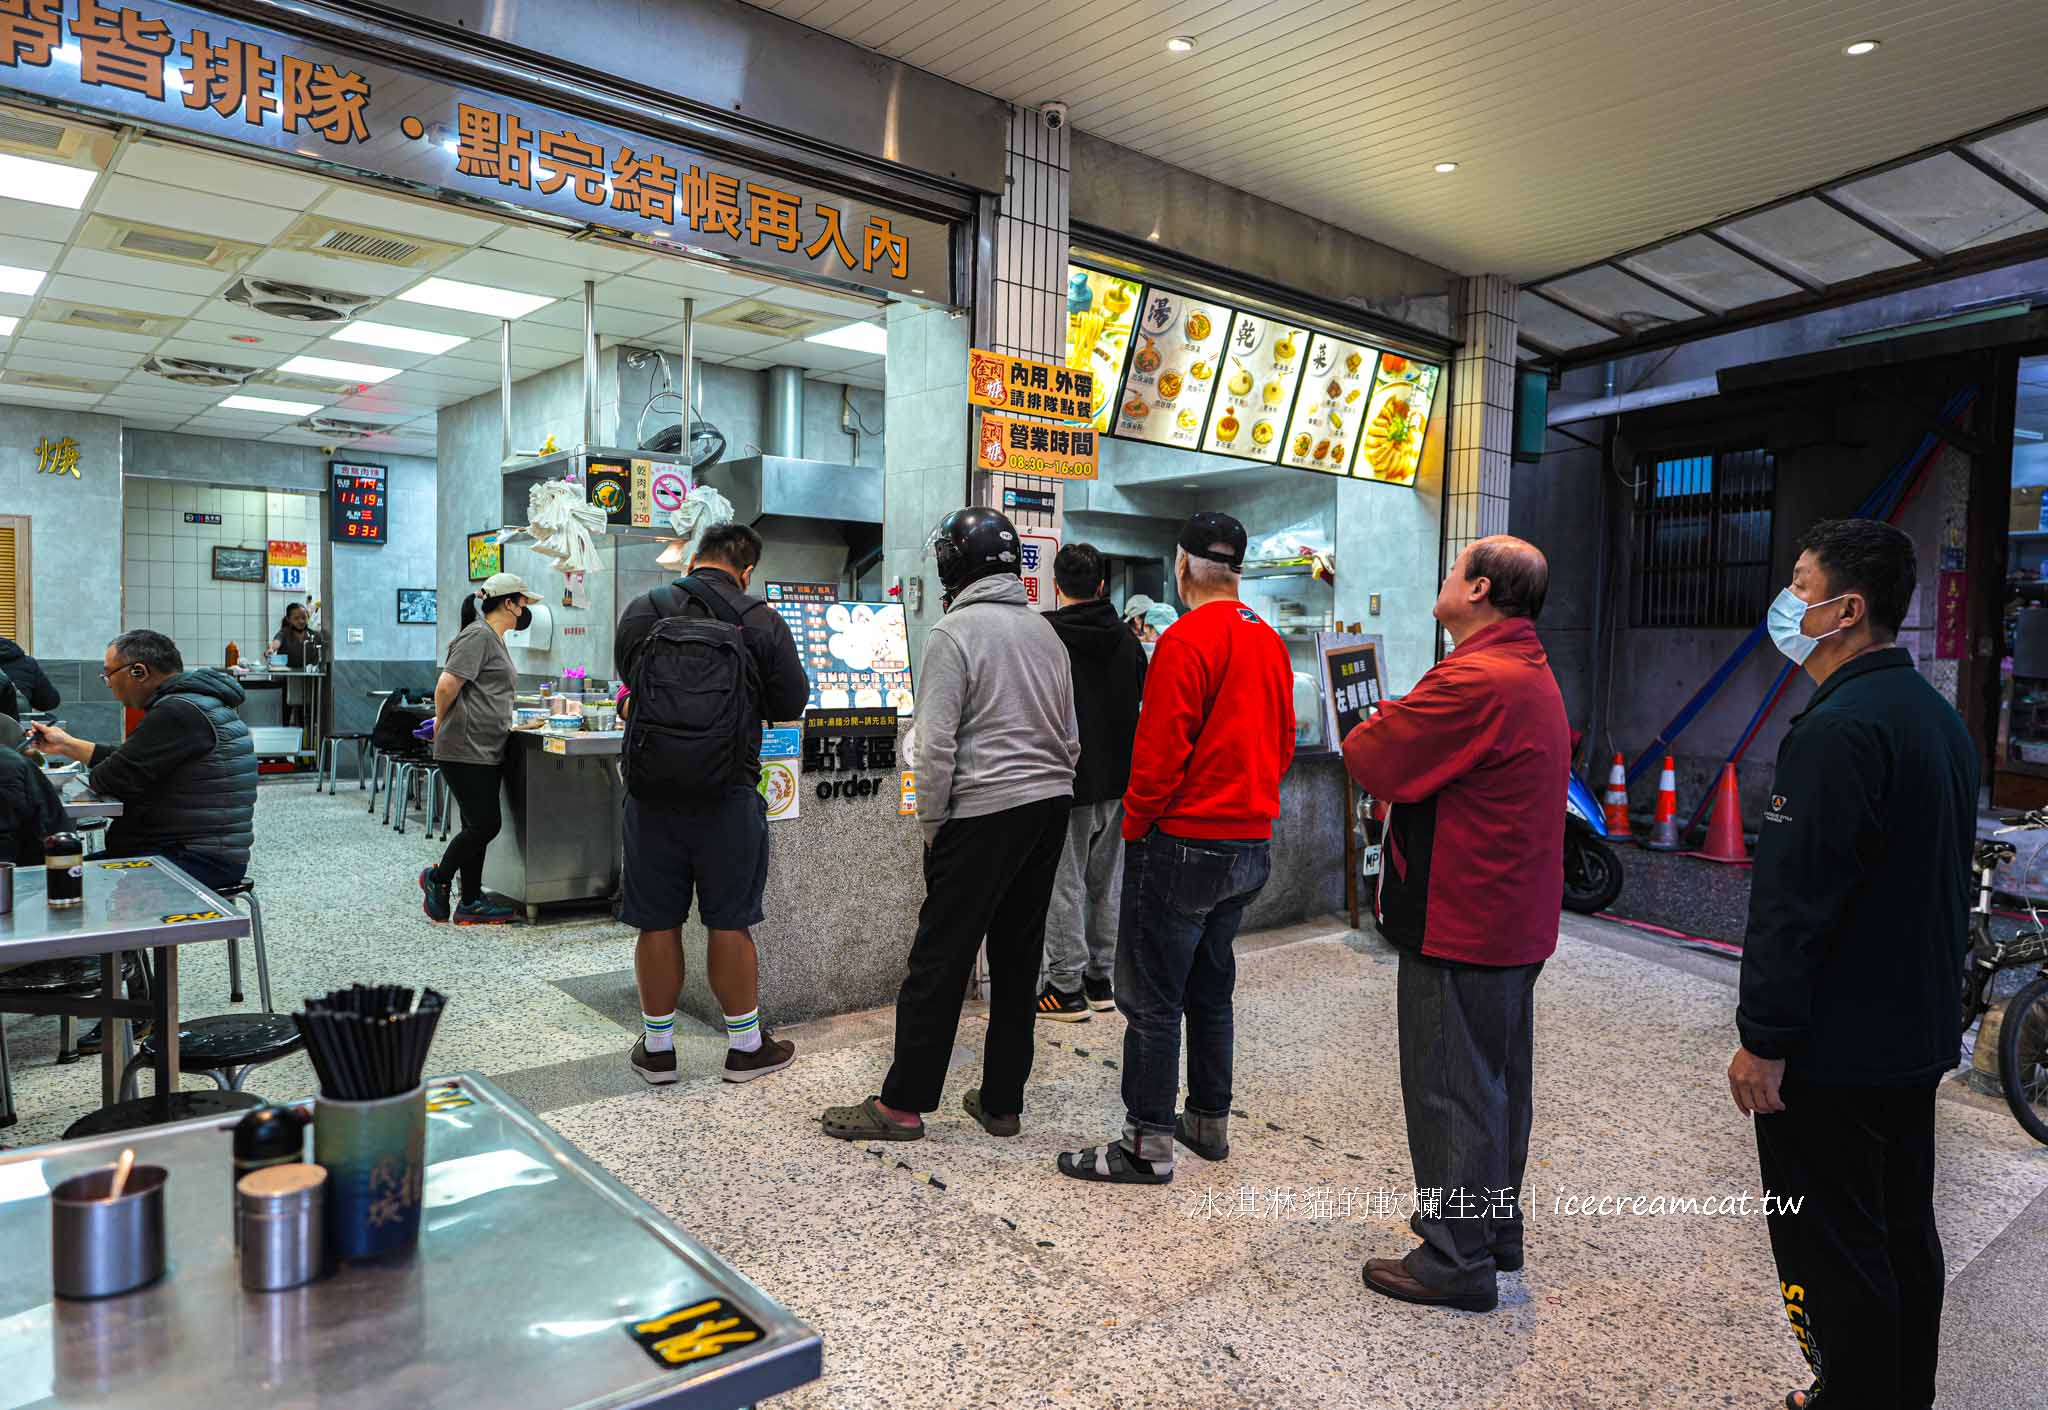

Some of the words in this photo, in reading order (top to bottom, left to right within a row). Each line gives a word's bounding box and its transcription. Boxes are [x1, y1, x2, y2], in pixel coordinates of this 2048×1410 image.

[1147, 297, 1172, 328] 湯
[1236, 319, 1255, 348] 乾
[1010, 389, 1091, 418] 請排隊點餐
[1010, 423, 1094, 456] 營業時間
[1008, 455, 1093, 475] 08:30~16:00
[633, 513, 650, 524] 250
[281, 567, 300, 585] 19
[816, 774, 882, 799] order
[1366, 852, 1379, 867] MP
